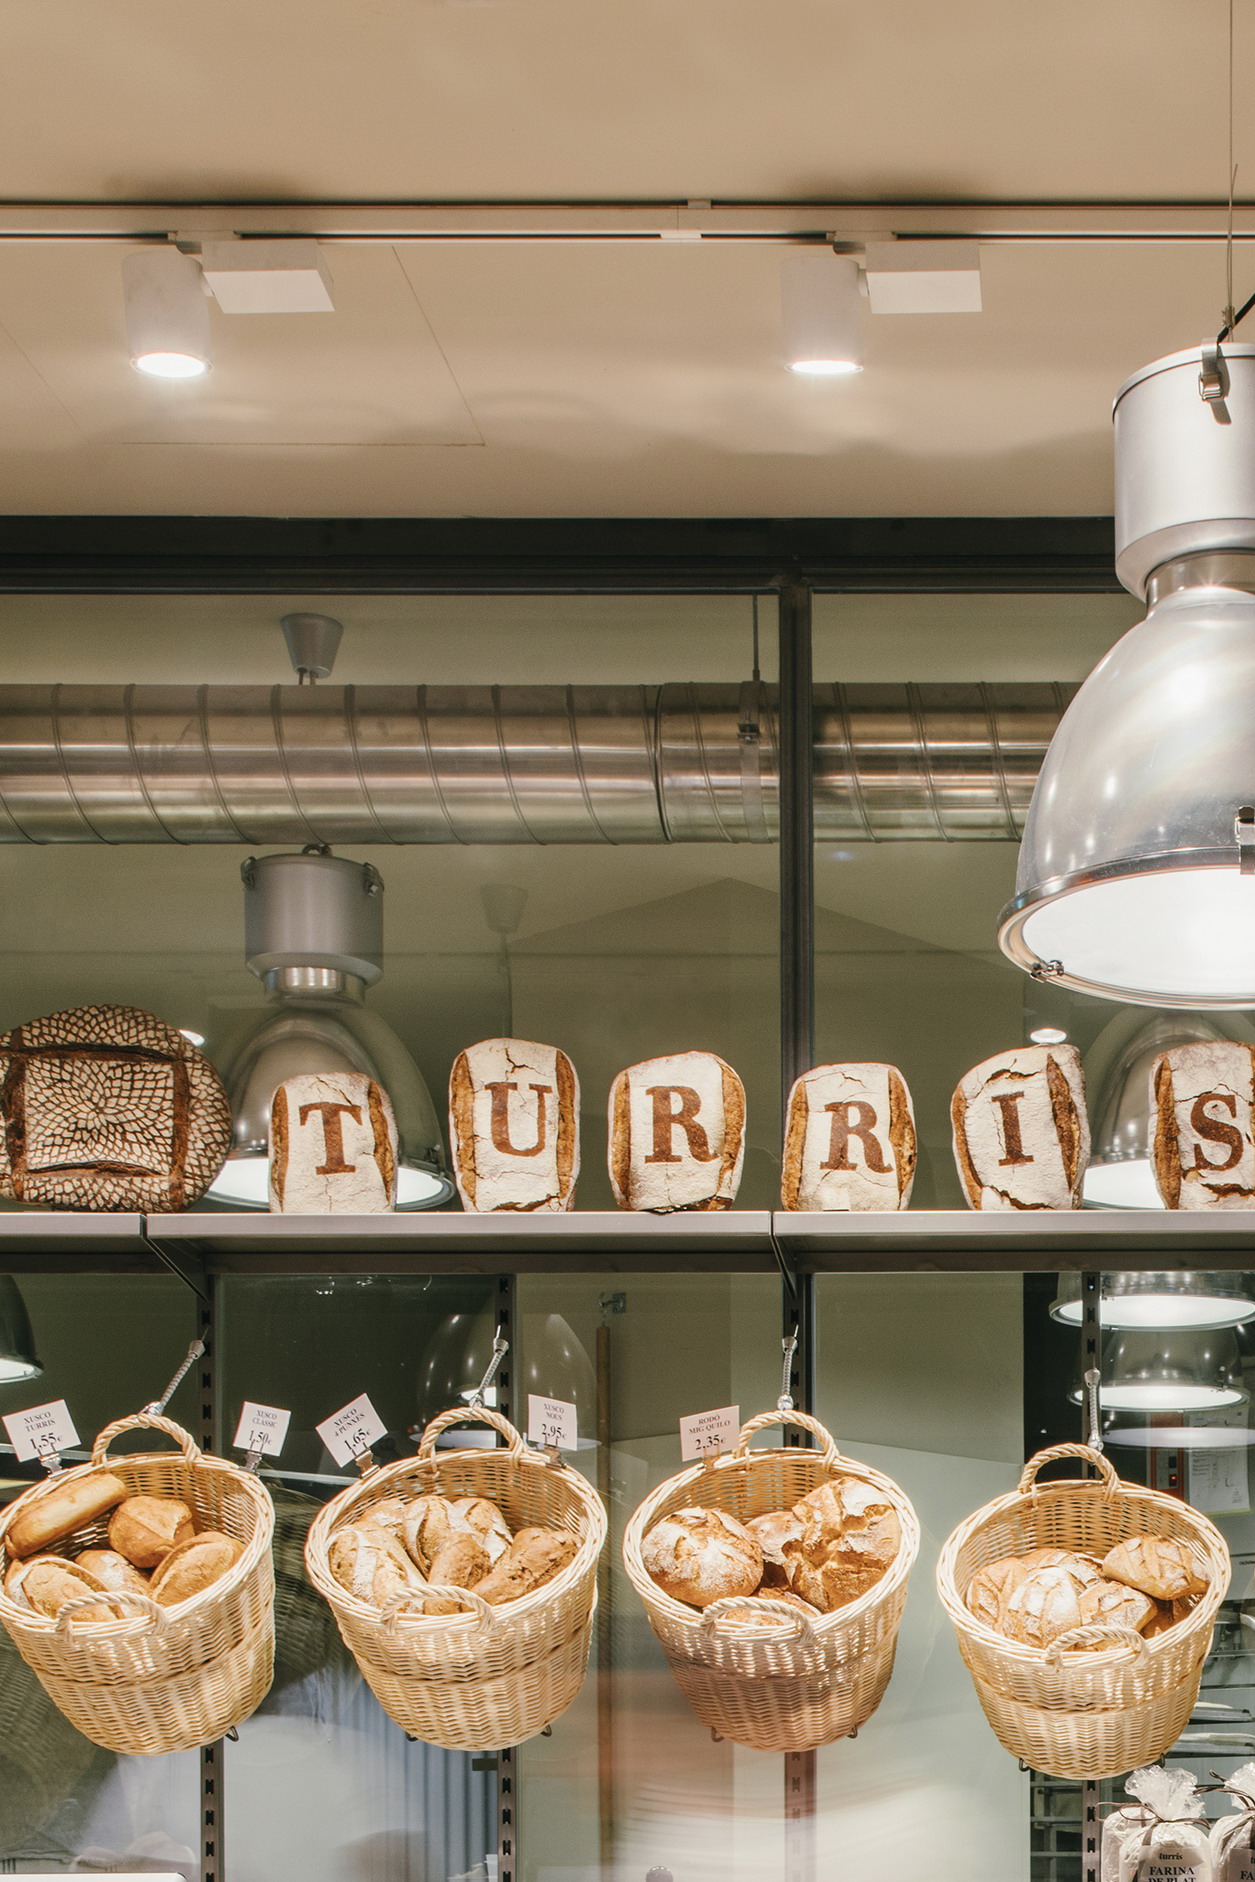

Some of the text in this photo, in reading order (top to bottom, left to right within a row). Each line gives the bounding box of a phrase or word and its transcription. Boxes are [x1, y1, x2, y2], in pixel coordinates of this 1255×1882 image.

[256, 1409, 277, 1420] XUSCO
[544, 1403, 565, 1414] XUSCO
[23, 1411, 51, 1424] XUSCO
[333, 1408, 358, 1428] XUSCO
[546, 1411, 563, 1421] NOUS
[25, 1419, 55, 1432] TURRIS
[252, 1418, 277, 1428] CLASSIC
[689, 1420, 731, 1434] MIG QUILO
[249, 1430, 273, 1445] 1,50€
[542, 1423, 567, 1440] 2,95€
[30, 1432, 63, 1450] 1,55€
[343, 1427, 373, 1450] 1,65€
[695, 1434, 726, 1451] 2,35€
[1159, 1852, 1183, 1861] turris
[1149, 1866, 1194, 1876] FARINA
